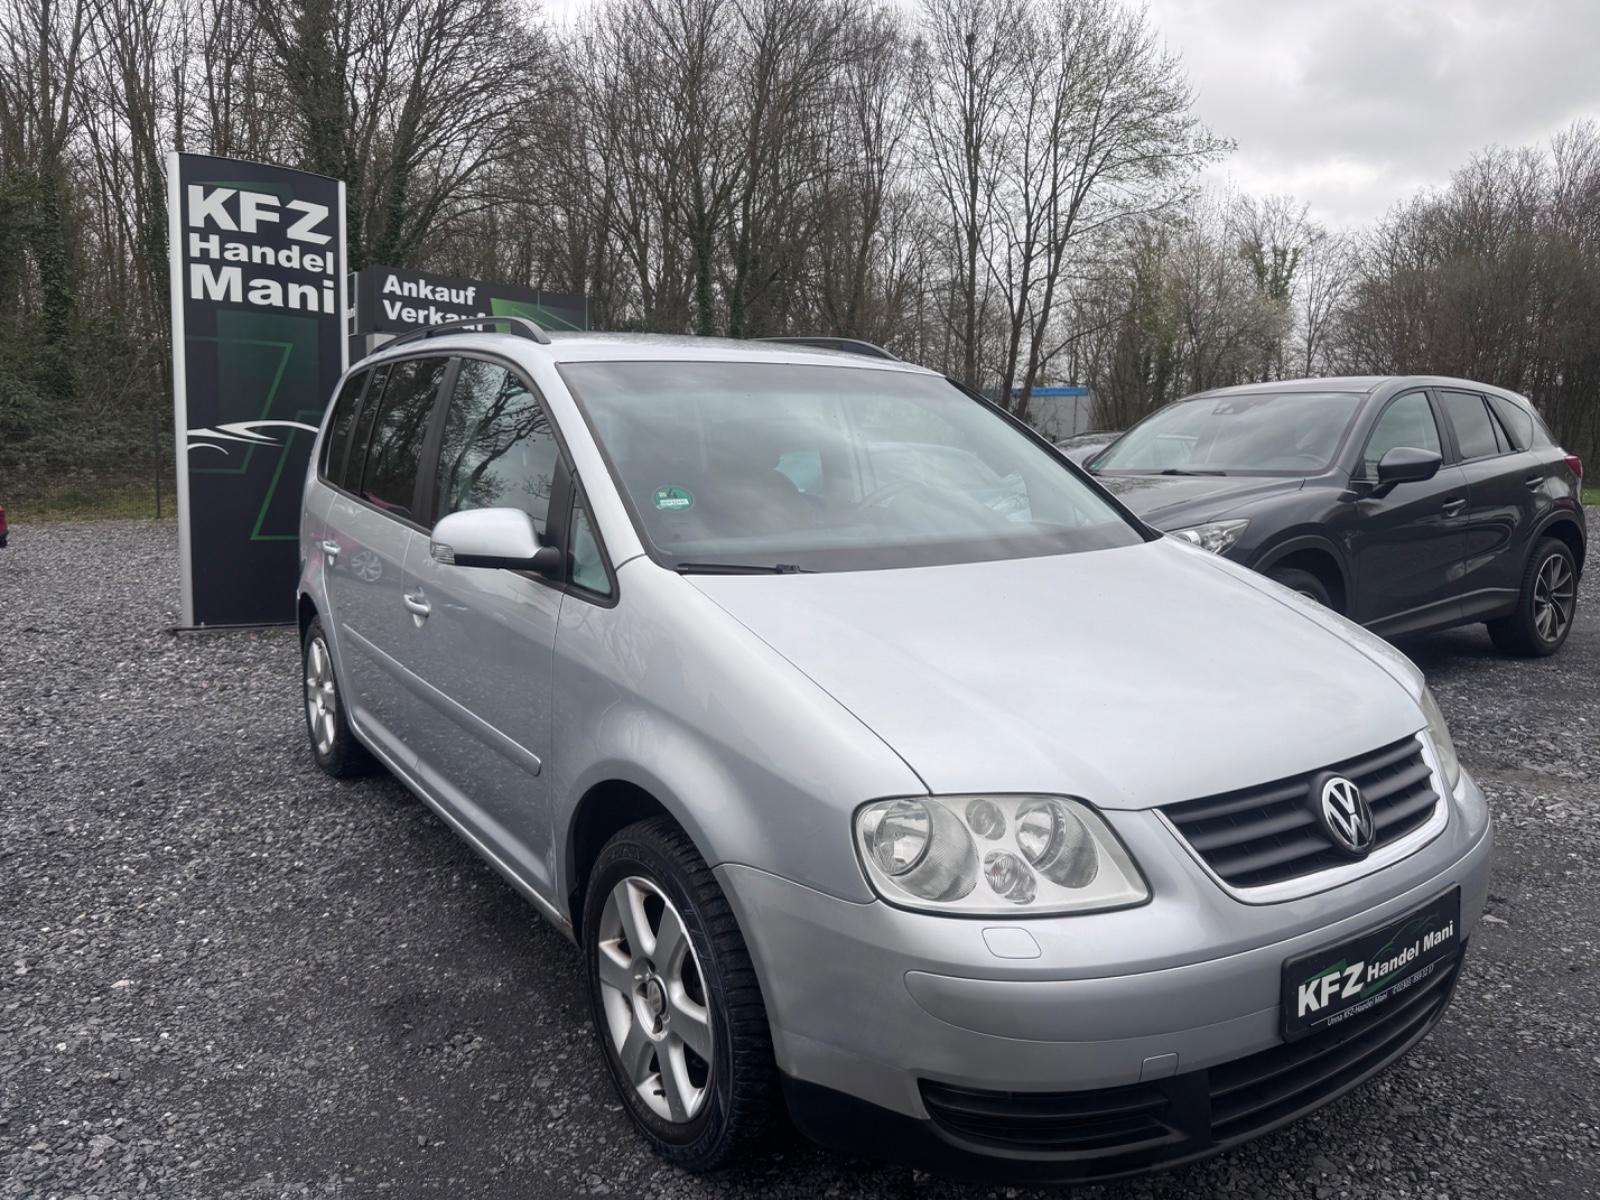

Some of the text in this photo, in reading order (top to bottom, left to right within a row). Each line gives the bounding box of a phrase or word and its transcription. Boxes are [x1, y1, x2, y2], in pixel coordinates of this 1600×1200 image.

[188, 184, 333, 246] KFZ
[189, 232, 334, 276] Handel
[190, 263, 335, 315] Mani
[382, 274, 477, 306] Ankauf
[1298, 960, 1366, 1018] KFZ
[1366, 940, 1420, 982] Handel
[1423, 920, 1454, 952] Mani
